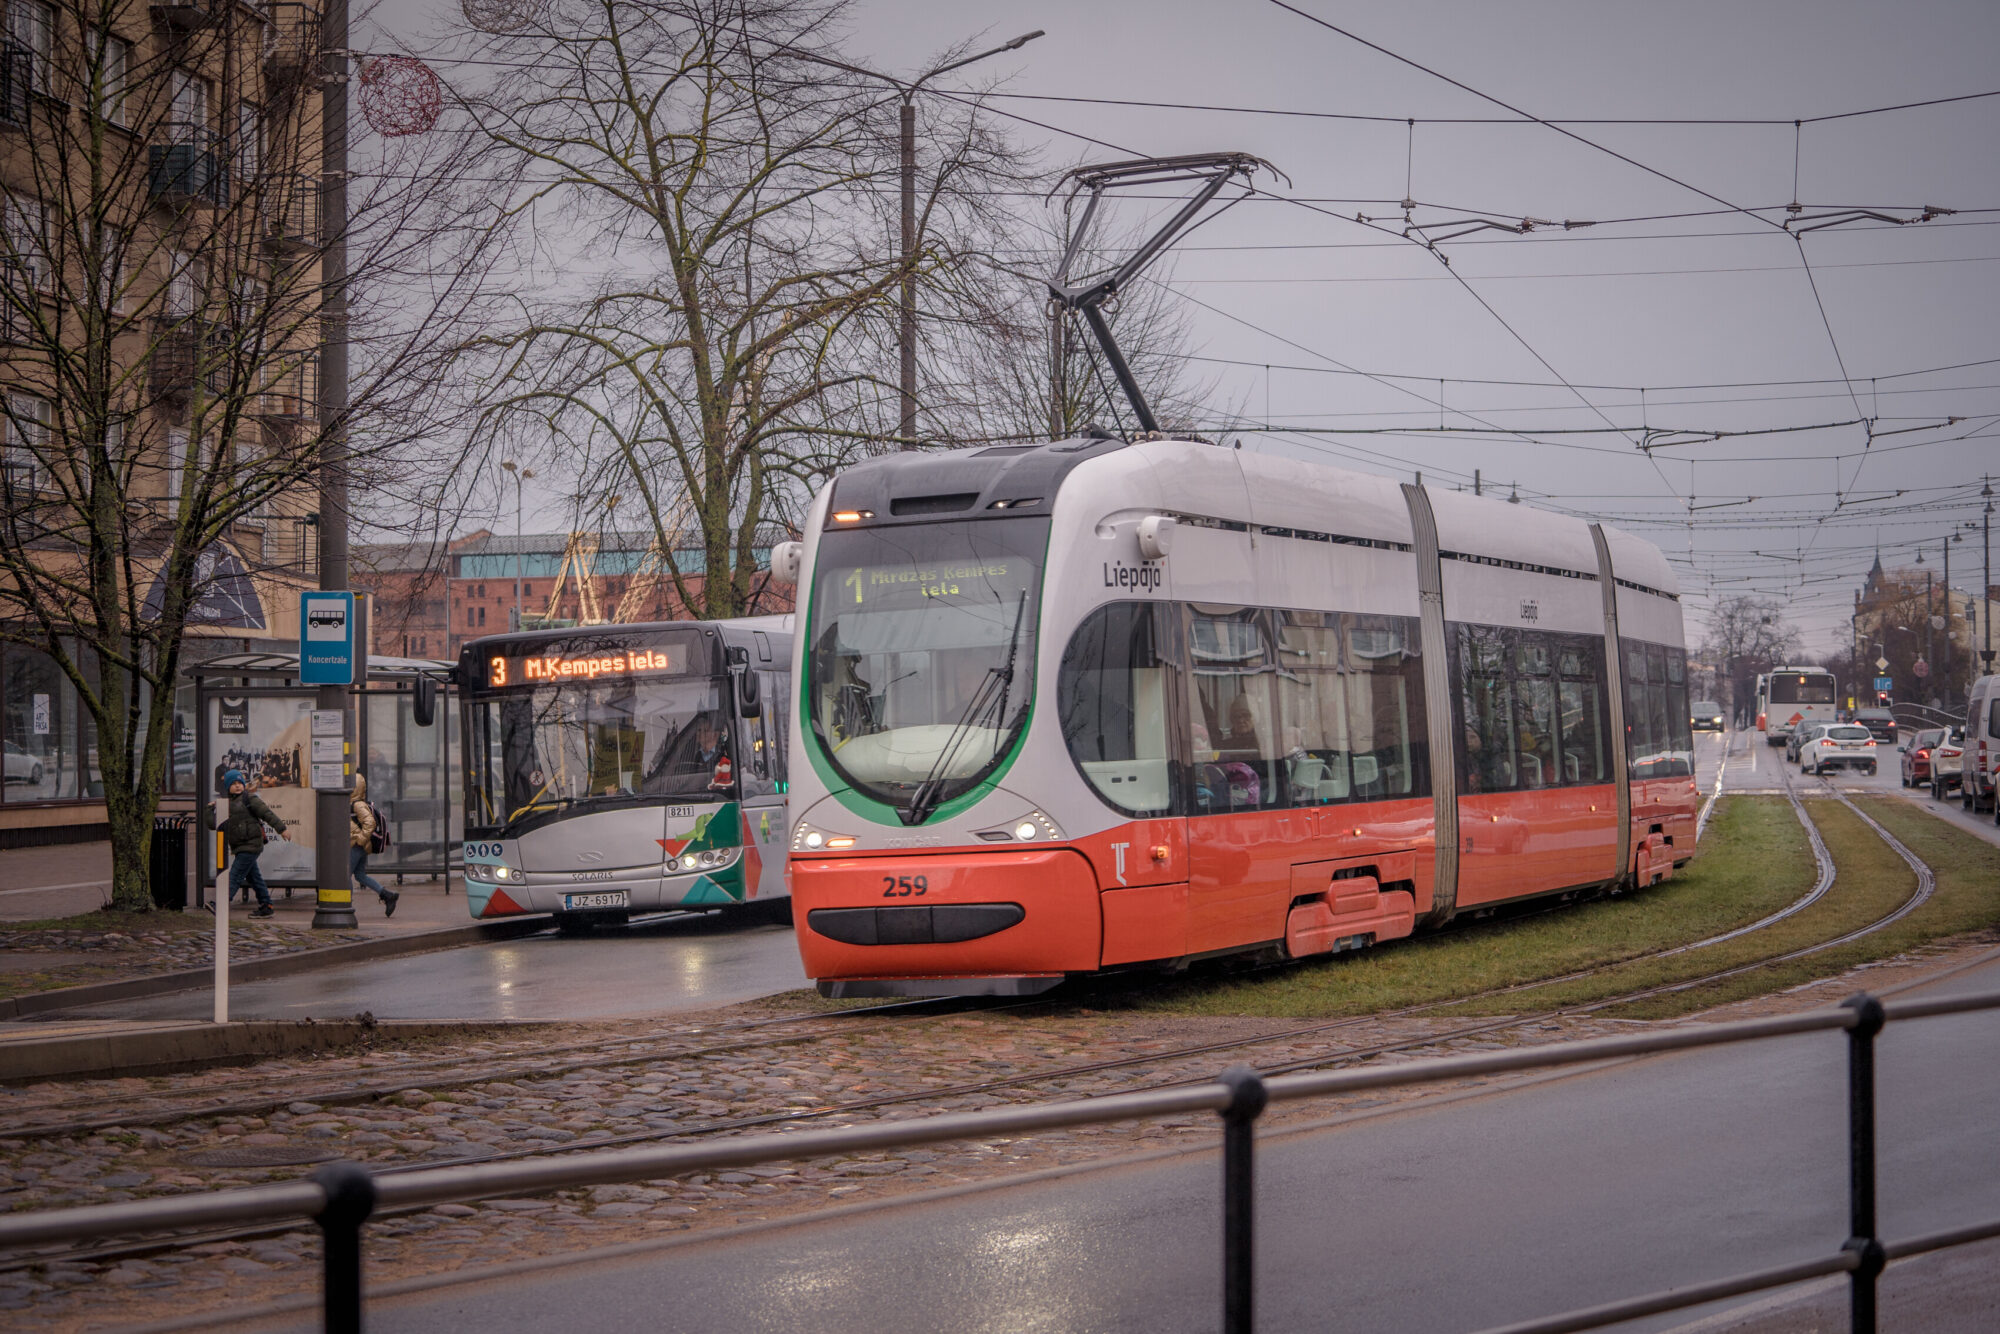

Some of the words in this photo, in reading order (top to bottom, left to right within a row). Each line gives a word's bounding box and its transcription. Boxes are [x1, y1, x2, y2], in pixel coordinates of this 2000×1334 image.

[845, 567, 863, 603] 1
[871, 569, 937, 585] Mirdzas
[1103, 560, 1161, 593] Liepāja
[920, 582, 960, 597] iela
[490, 656, 506, 686] 3
[628, 650, 668, 671] iela
[670, 807, 691, 817] 8211
[572, 871, 614, 881] SOLARIS
[882, 875, 928, 898] 259
